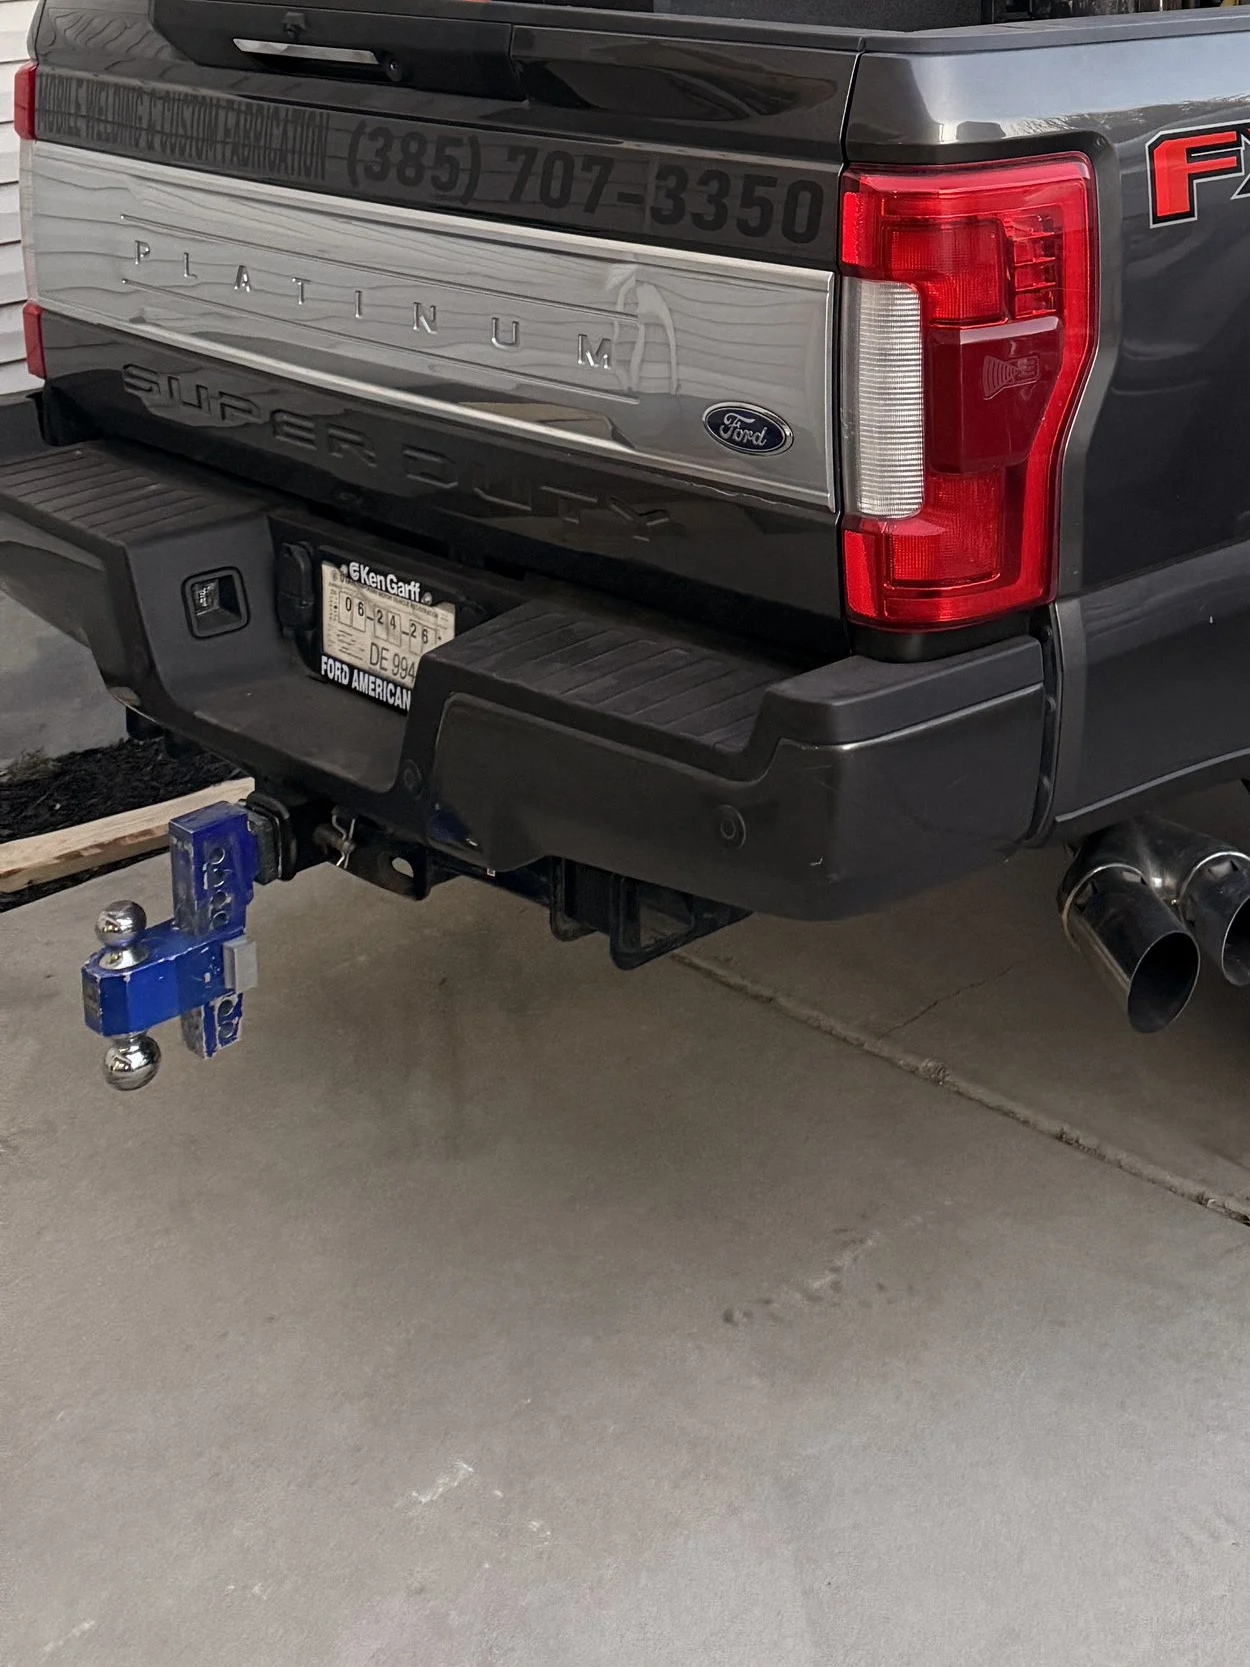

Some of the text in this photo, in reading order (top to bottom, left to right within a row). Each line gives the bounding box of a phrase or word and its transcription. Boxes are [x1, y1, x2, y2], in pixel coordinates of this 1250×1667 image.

[222, 97, 330, 181] FABRICATION
[346, 119, 825, 244] (385) 707-3350
[134, 239, 613, 370] PLATINUM
[121, 362, 377, 469] SUPER
[719, 412, 768, 446] Ford
[321, 655, 412, 711] FORD AMERICAN
[369, 641, 389, 672] DE
